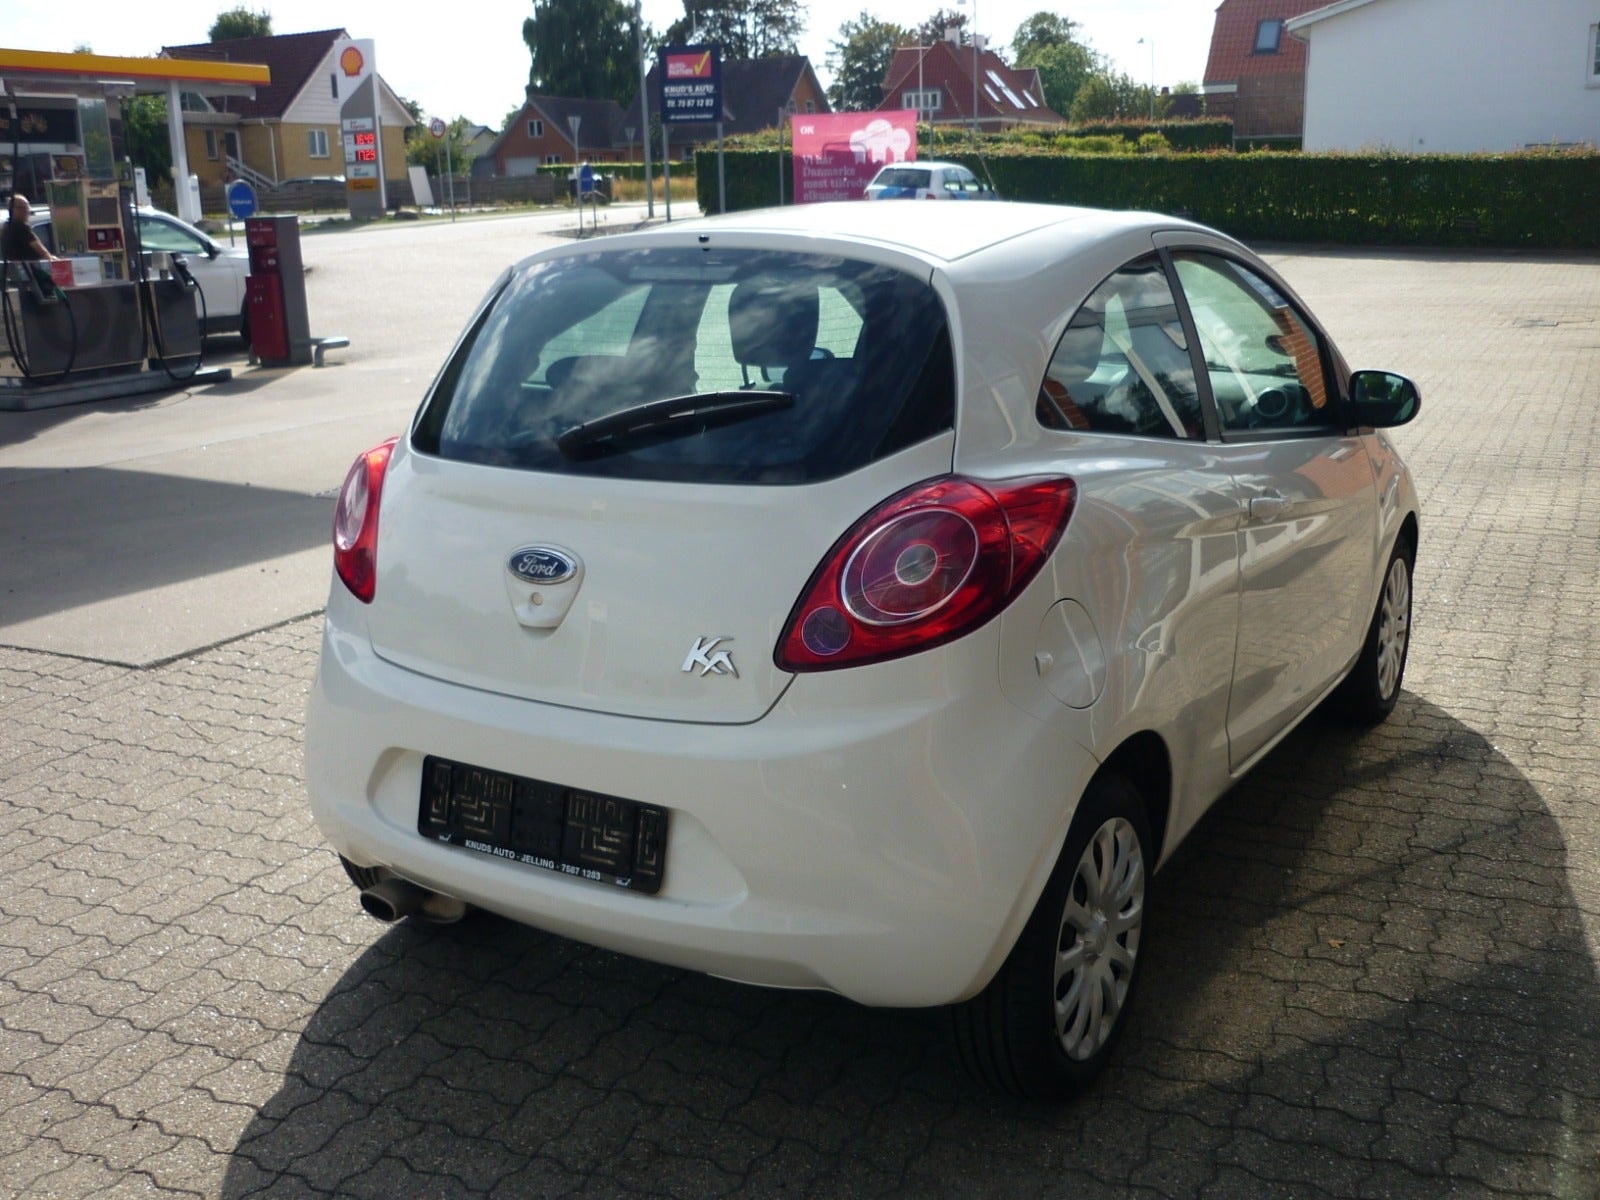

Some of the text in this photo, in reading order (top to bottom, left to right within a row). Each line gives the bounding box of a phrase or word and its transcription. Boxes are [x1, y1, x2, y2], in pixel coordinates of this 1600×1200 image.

[800, 126, 815, 135] OK
[803, 154, 833, 165] Vi har
[803, 165, 856, 177] Danmarks
[803, 179, 828, 189] mest
[518, 552, 559, 577] Ford
[465, 839, 493, 854] KNUDS
[493, 845, 516, 861] AUTO
[520, 853, 555, 870] JELLING
[561, 863, 580, 875] 7587
[582, 868, 601, 881] 1283
